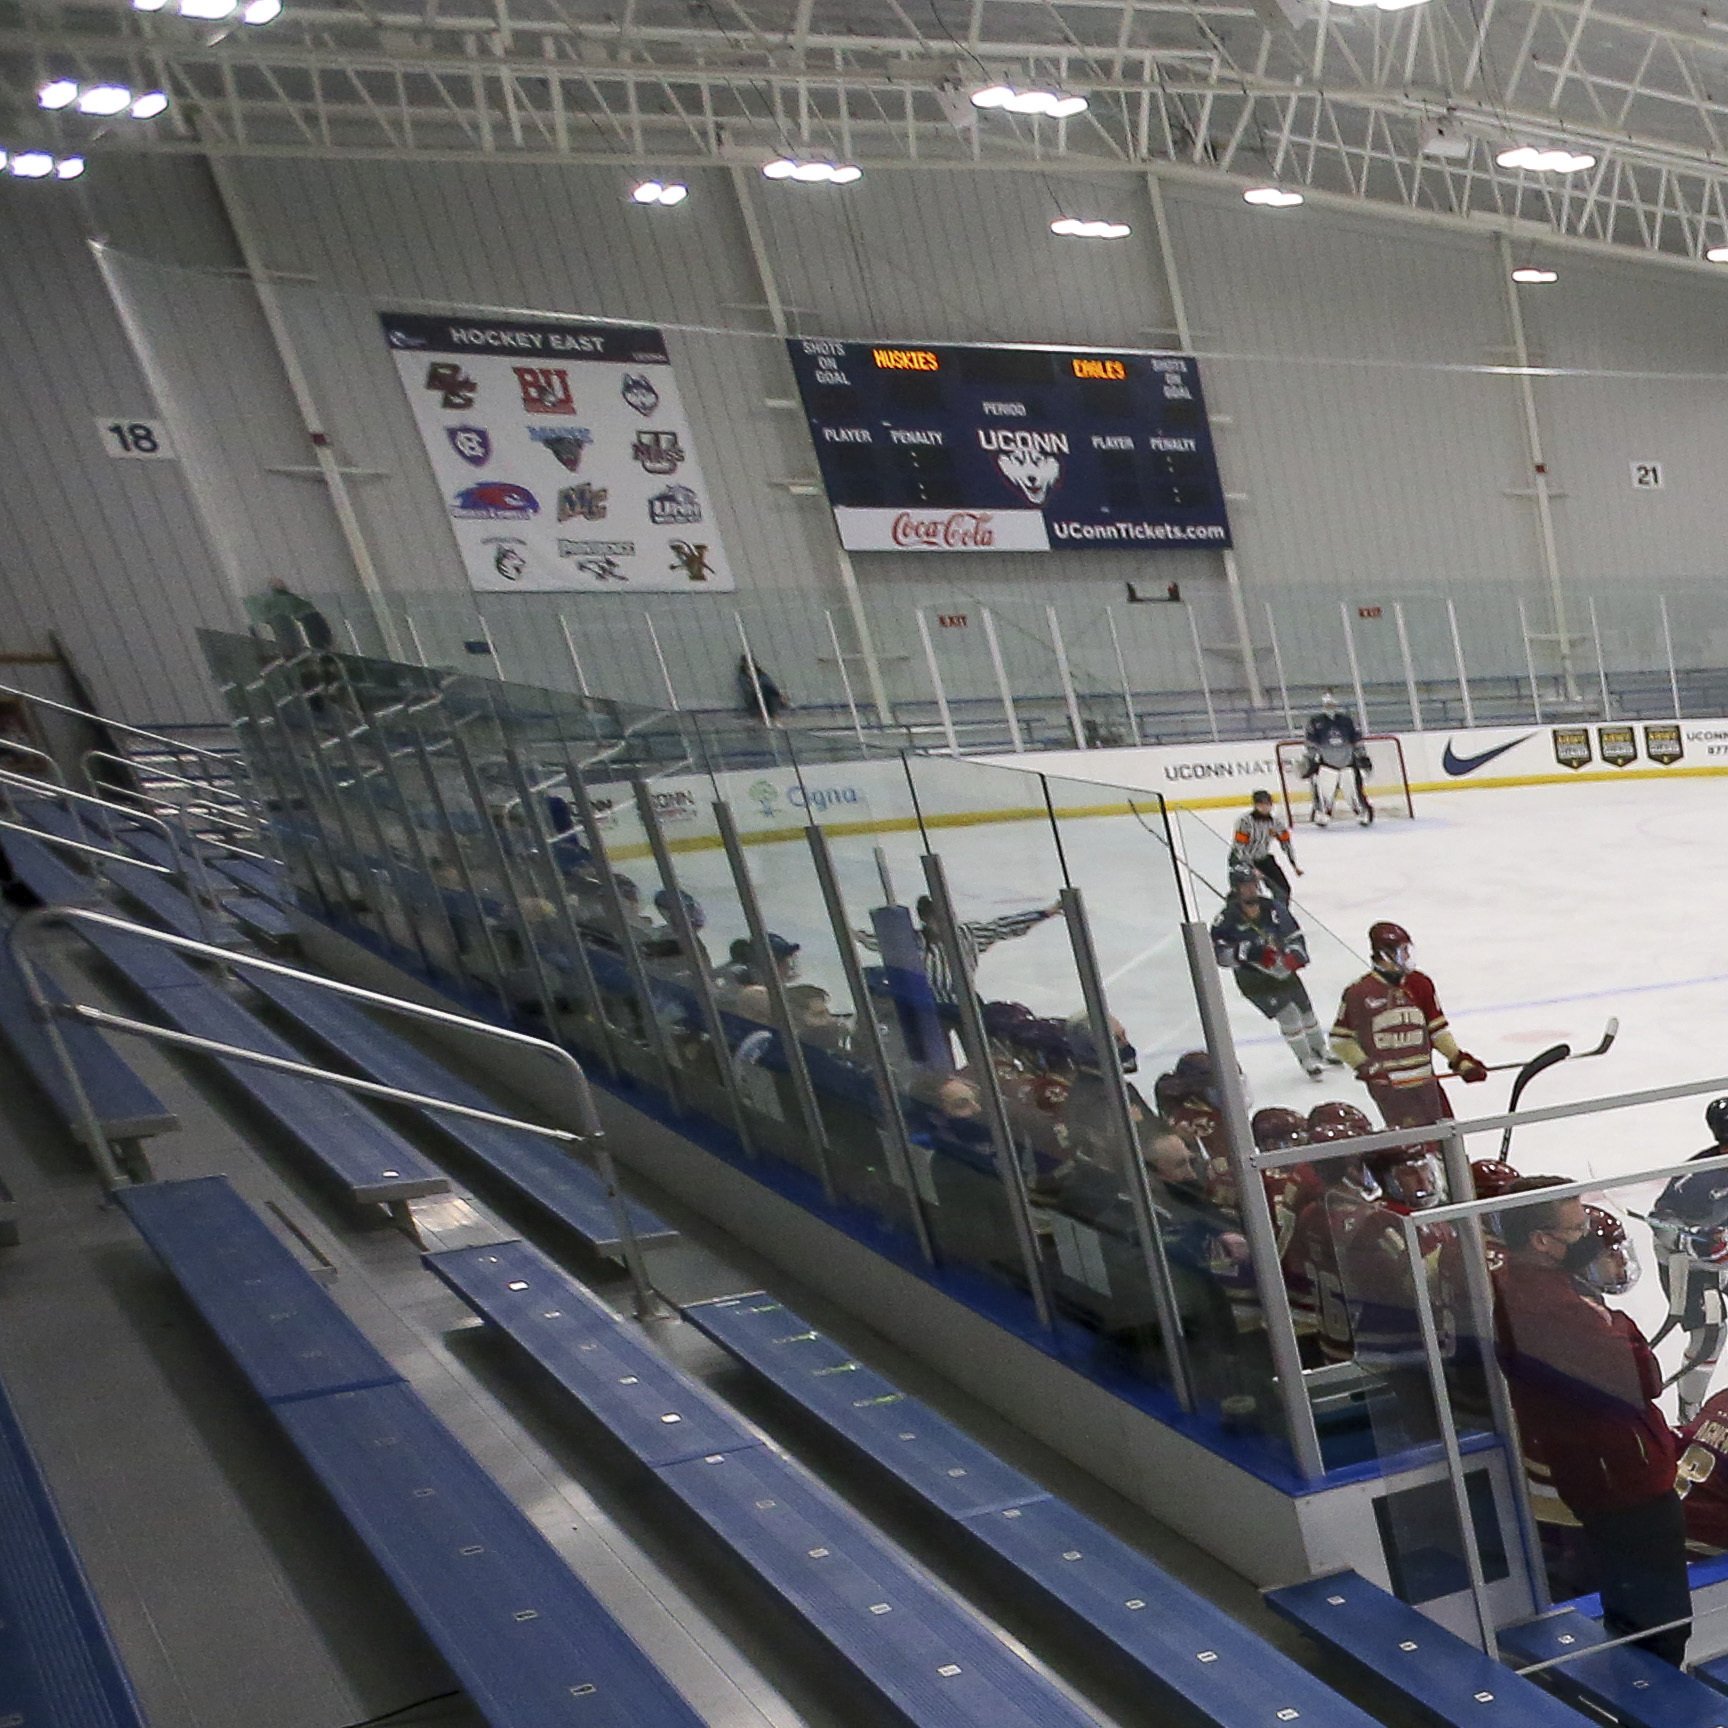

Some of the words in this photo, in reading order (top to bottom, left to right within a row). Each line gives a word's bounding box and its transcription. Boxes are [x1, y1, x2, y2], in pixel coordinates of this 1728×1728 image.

[451, 327, 546, 350] HOCKEY
[549, 333, 605, 353] EAST
[803, 341, 845, 356] SHOTS
[817, 356, 837, 370] ON
[873, 349, 940, 371] HUSKIES
[815, 370, 851, 385] GOAL
[108, 422, 159, 453] 18
[822, 427, 873, 443] PLAYER
[890, 430, 943, 445] PENALTY
[977, 428, 1070, 454] UCONN
[1636, 464, 1657, 485] 21
[892, 511, 994, 548] Coca-Cola
[1052, 521, 1227, 541] UConnTickets.com
[1164, 763, 1233, 781] UCONN
[786, 784, 857, 812] Cigna
